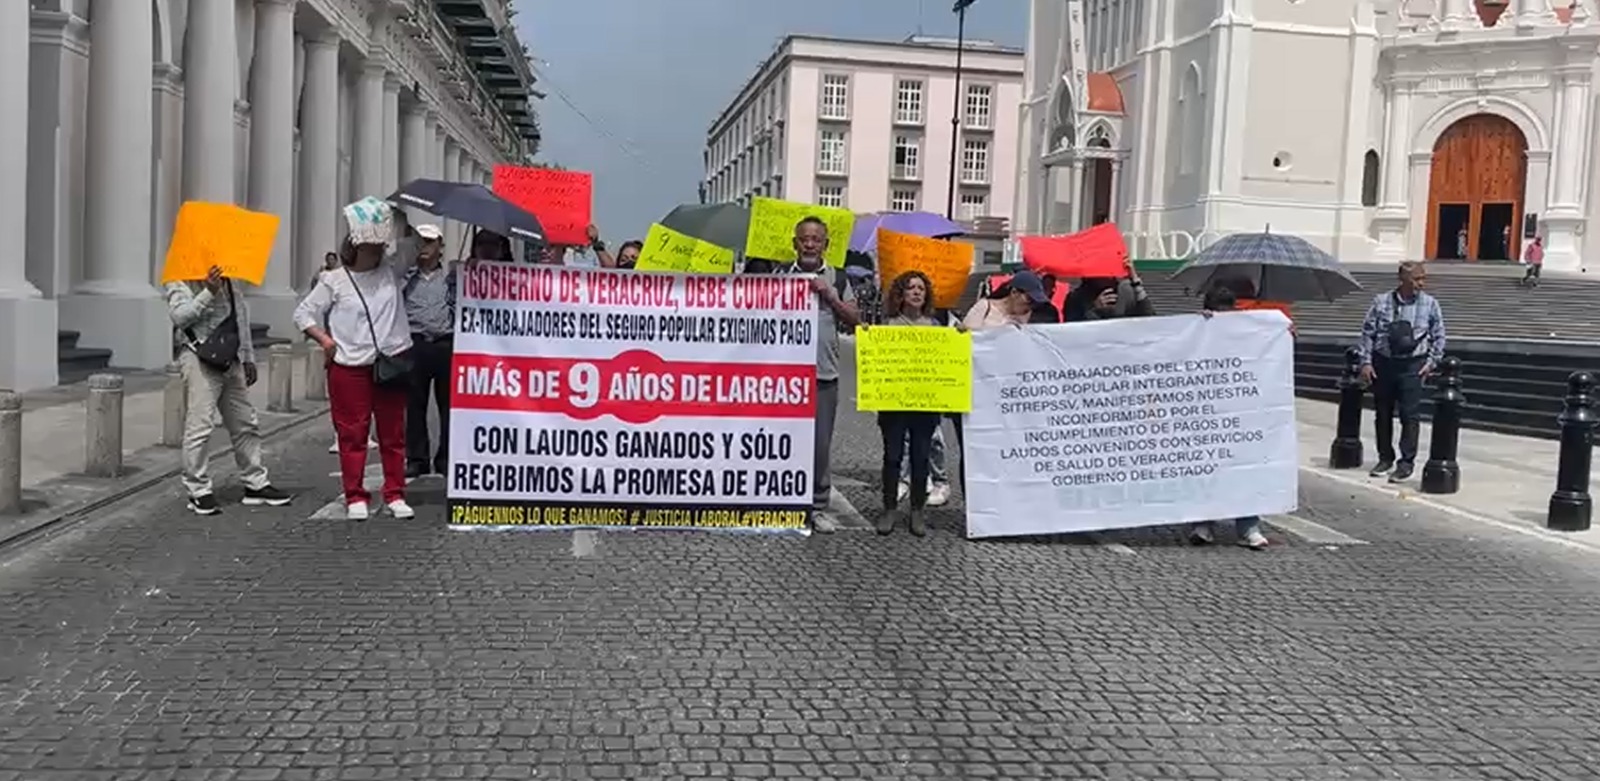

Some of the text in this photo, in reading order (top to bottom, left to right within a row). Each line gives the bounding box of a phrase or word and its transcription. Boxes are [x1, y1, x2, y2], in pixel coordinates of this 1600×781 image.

[463, 268, 812, 311] ¡GOBIERNO DE VERACRUZ, DEBE CUMPLIR!
[461, 307, 811, 345] EX-TRABAJADORES DEL SEGURO POPULAR EXIGIMOS PAGO
[1155, 362, 1179, 373] DEL
[1185, 357, 1242, 370] EXTINTO
[457, 362, 809, 408] ¡MÁS DE 9 AÑOS DE LARGAS!
[1000, 371, 1257, 398] SEGURO POPULAR INTEGRANTES DEL
[1001, 385, 1259, 414] SITREPSSV, MANIFESTAMOS NUESTRA
[1024, 416, 1240, 443] INCUMPLIMIENTO DE PAGOS DE
[1047, 405, 1216, 426] INCONFORMIDAD POR EL
[474, 426, 791, 460] CON LAUDOS GANADOS Y SÓLO
[1001, 430, 1263, 459] LAUDOS CONVENIDOS CON SERVICIOS
[1035, 448, 1234, 473] DE SALUD DE VERACRUZ Y EL
[454, 464, 807, 497] RECIBIMOS LA PROMESA DE PAGO
[1052, 472, 1126, 486] GOBIERNO
[1131, 469, 1155, 482] DEL
[527, 507, 541, 524] LO
[545, 507, 563, 525] QUE
[565, 508, 627, 525] GANAMOS!
[643, 509, 690, 526] JUSTICIA
